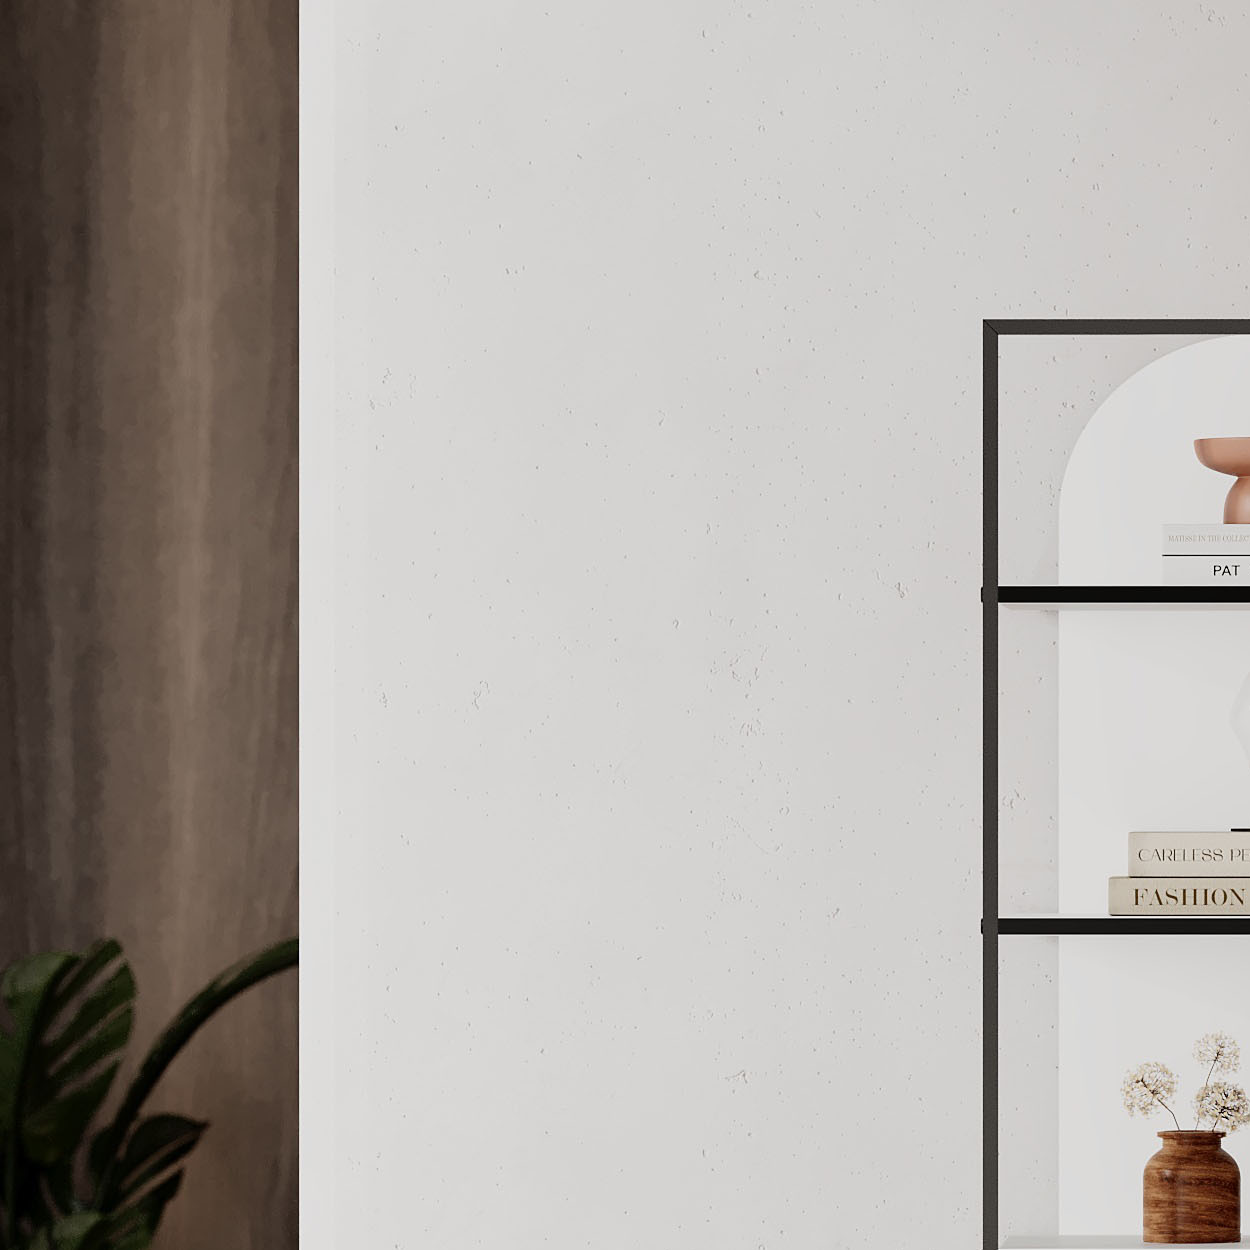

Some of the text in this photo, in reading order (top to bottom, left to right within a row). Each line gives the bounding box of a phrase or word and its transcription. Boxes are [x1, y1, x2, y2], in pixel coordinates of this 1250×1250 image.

[1213, 564, 1241, 577] PAT
[1138, 848, 1224, 862] CARELESS
[1133, 888, 1246, 906] FASHION
